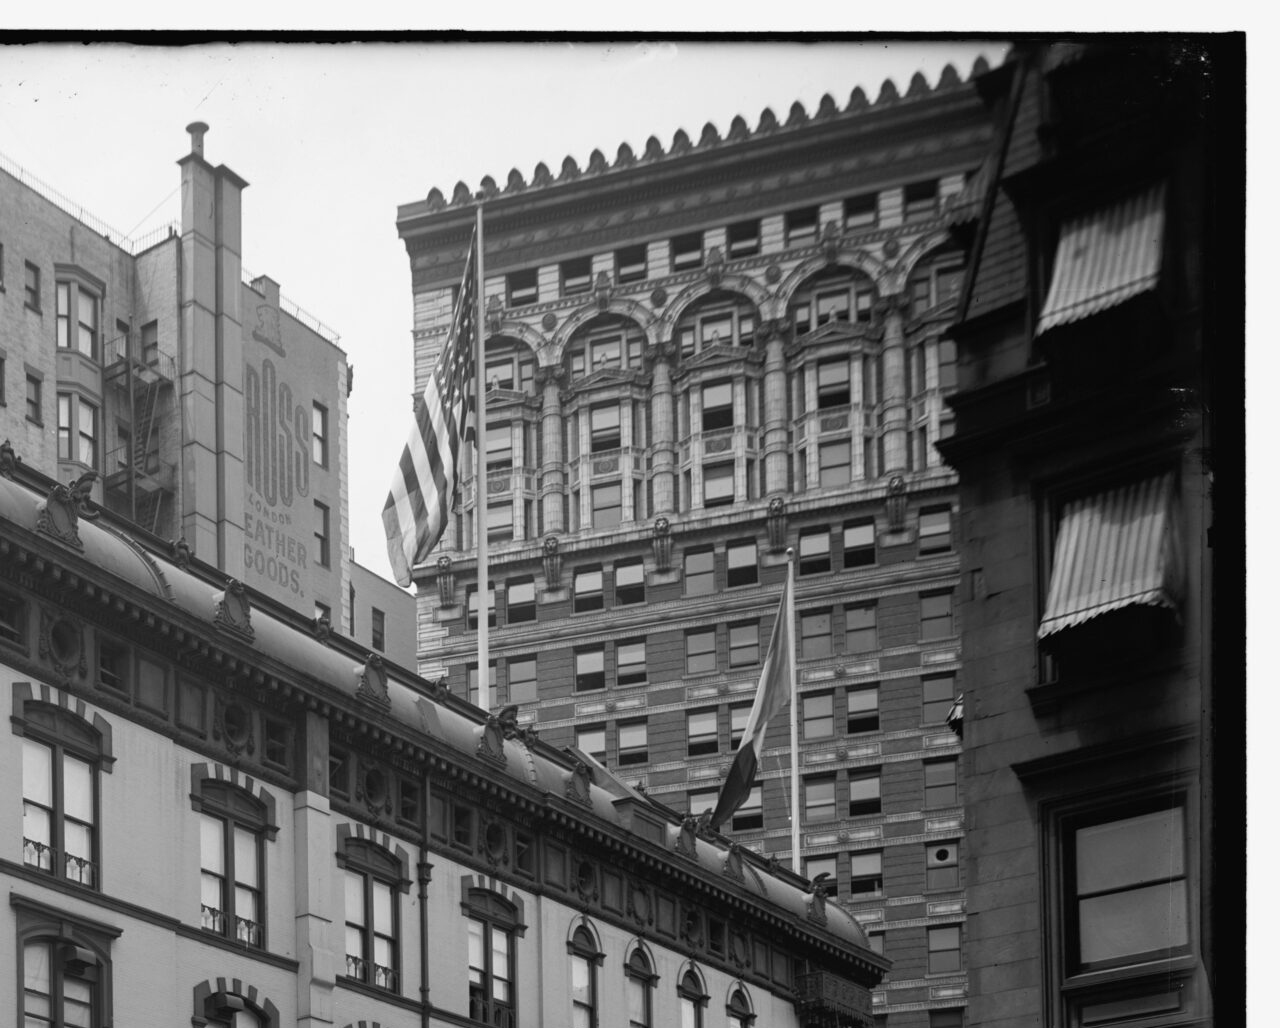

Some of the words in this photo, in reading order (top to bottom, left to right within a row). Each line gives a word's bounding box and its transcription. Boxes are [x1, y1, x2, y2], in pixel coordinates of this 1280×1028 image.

[246, 358, 310, 508] ROSS
[248, 493, 293, 525] LONDON
[244, 512, 308, 569] EATHER
[243, 542, 305, 598] GOODS.
